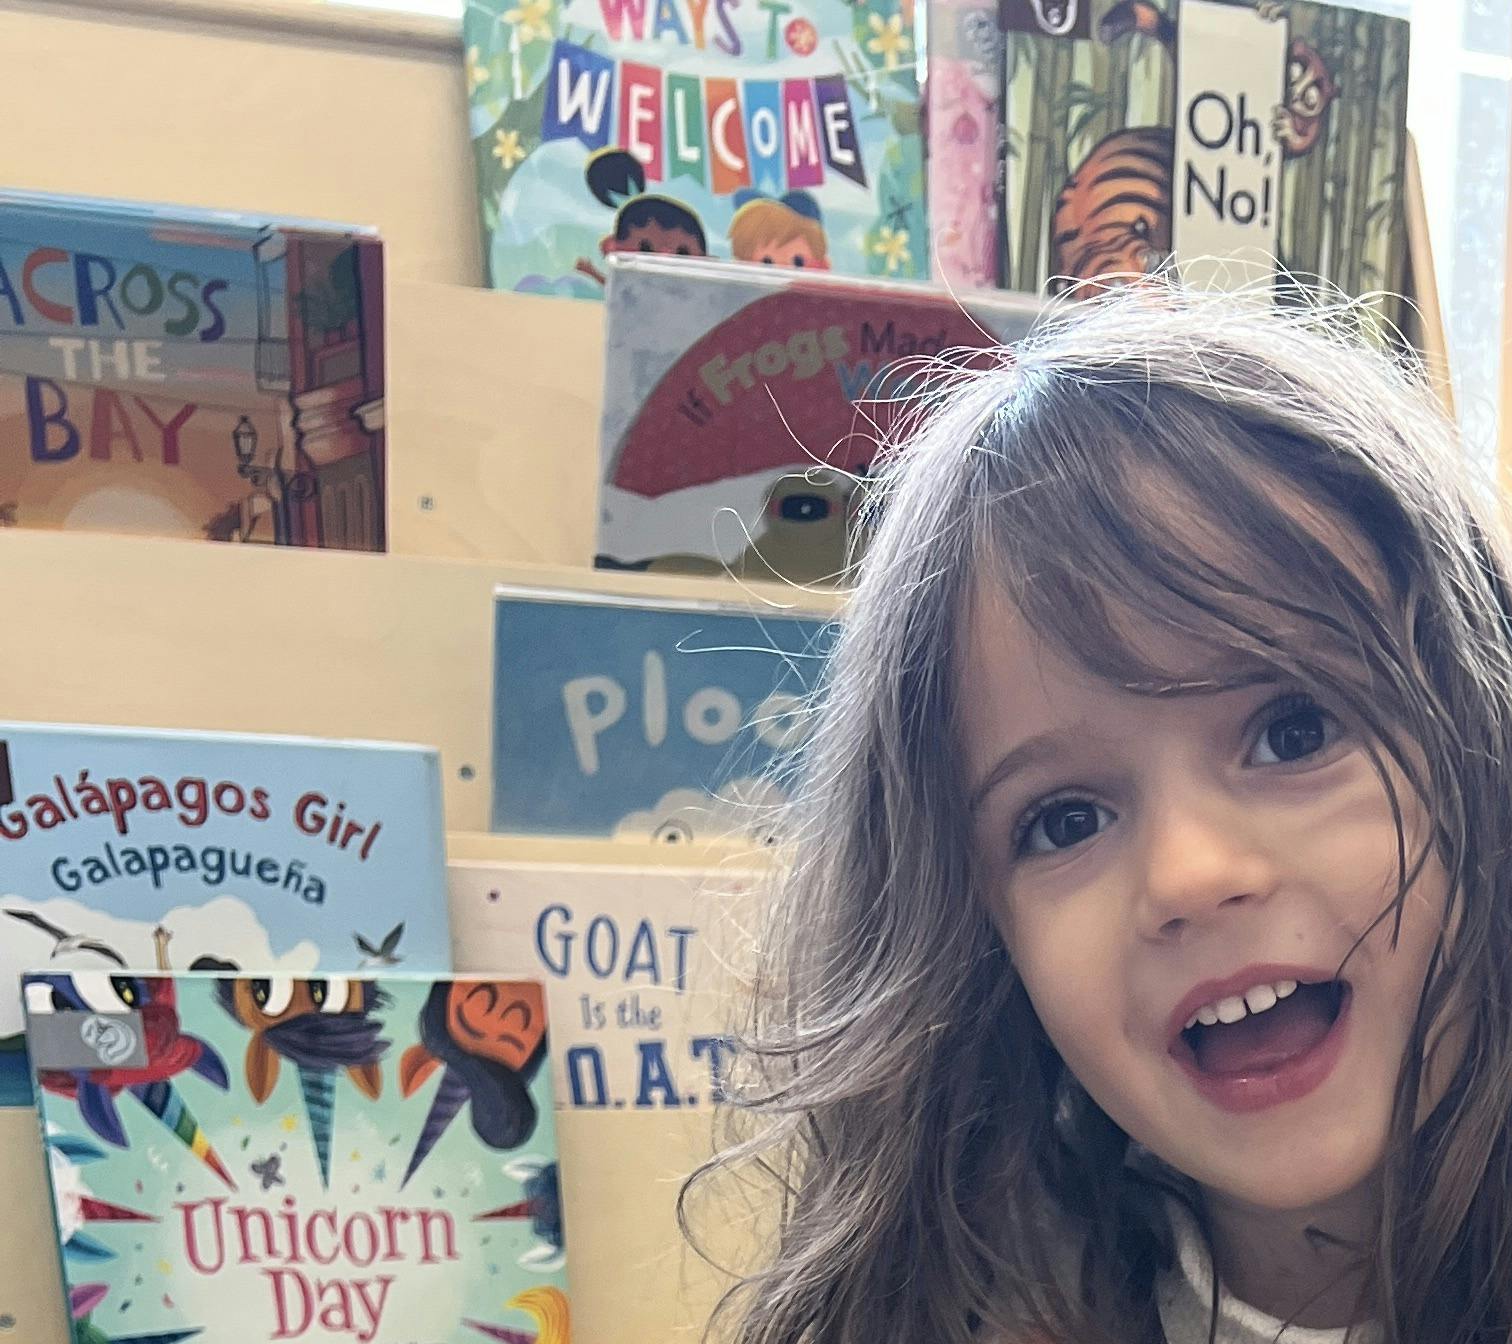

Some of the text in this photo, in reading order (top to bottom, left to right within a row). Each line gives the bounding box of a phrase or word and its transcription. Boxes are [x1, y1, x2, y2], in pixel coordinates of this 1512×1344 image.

[600, 0, 743, 55] WAYS
[558, 58, 856, 171] WELCOME
[1188, 90, 1272, 168] Oh,
[1186, 160, 1270, 227] No!
[50, 337, 166, 381] THE
[700, 324, 850, 403] Frogs
[25, 375, 199, 466] BAY
[295, 792, 382, 861] Girl
[51, 841, 327, 904] Galapagueña
[536, 902, 698, 993] GOAT
[616, 993, 663, 1030] the
[173, 1195, 460, 1275] Unicorn
[261, 1267, 397, 1342] Day
